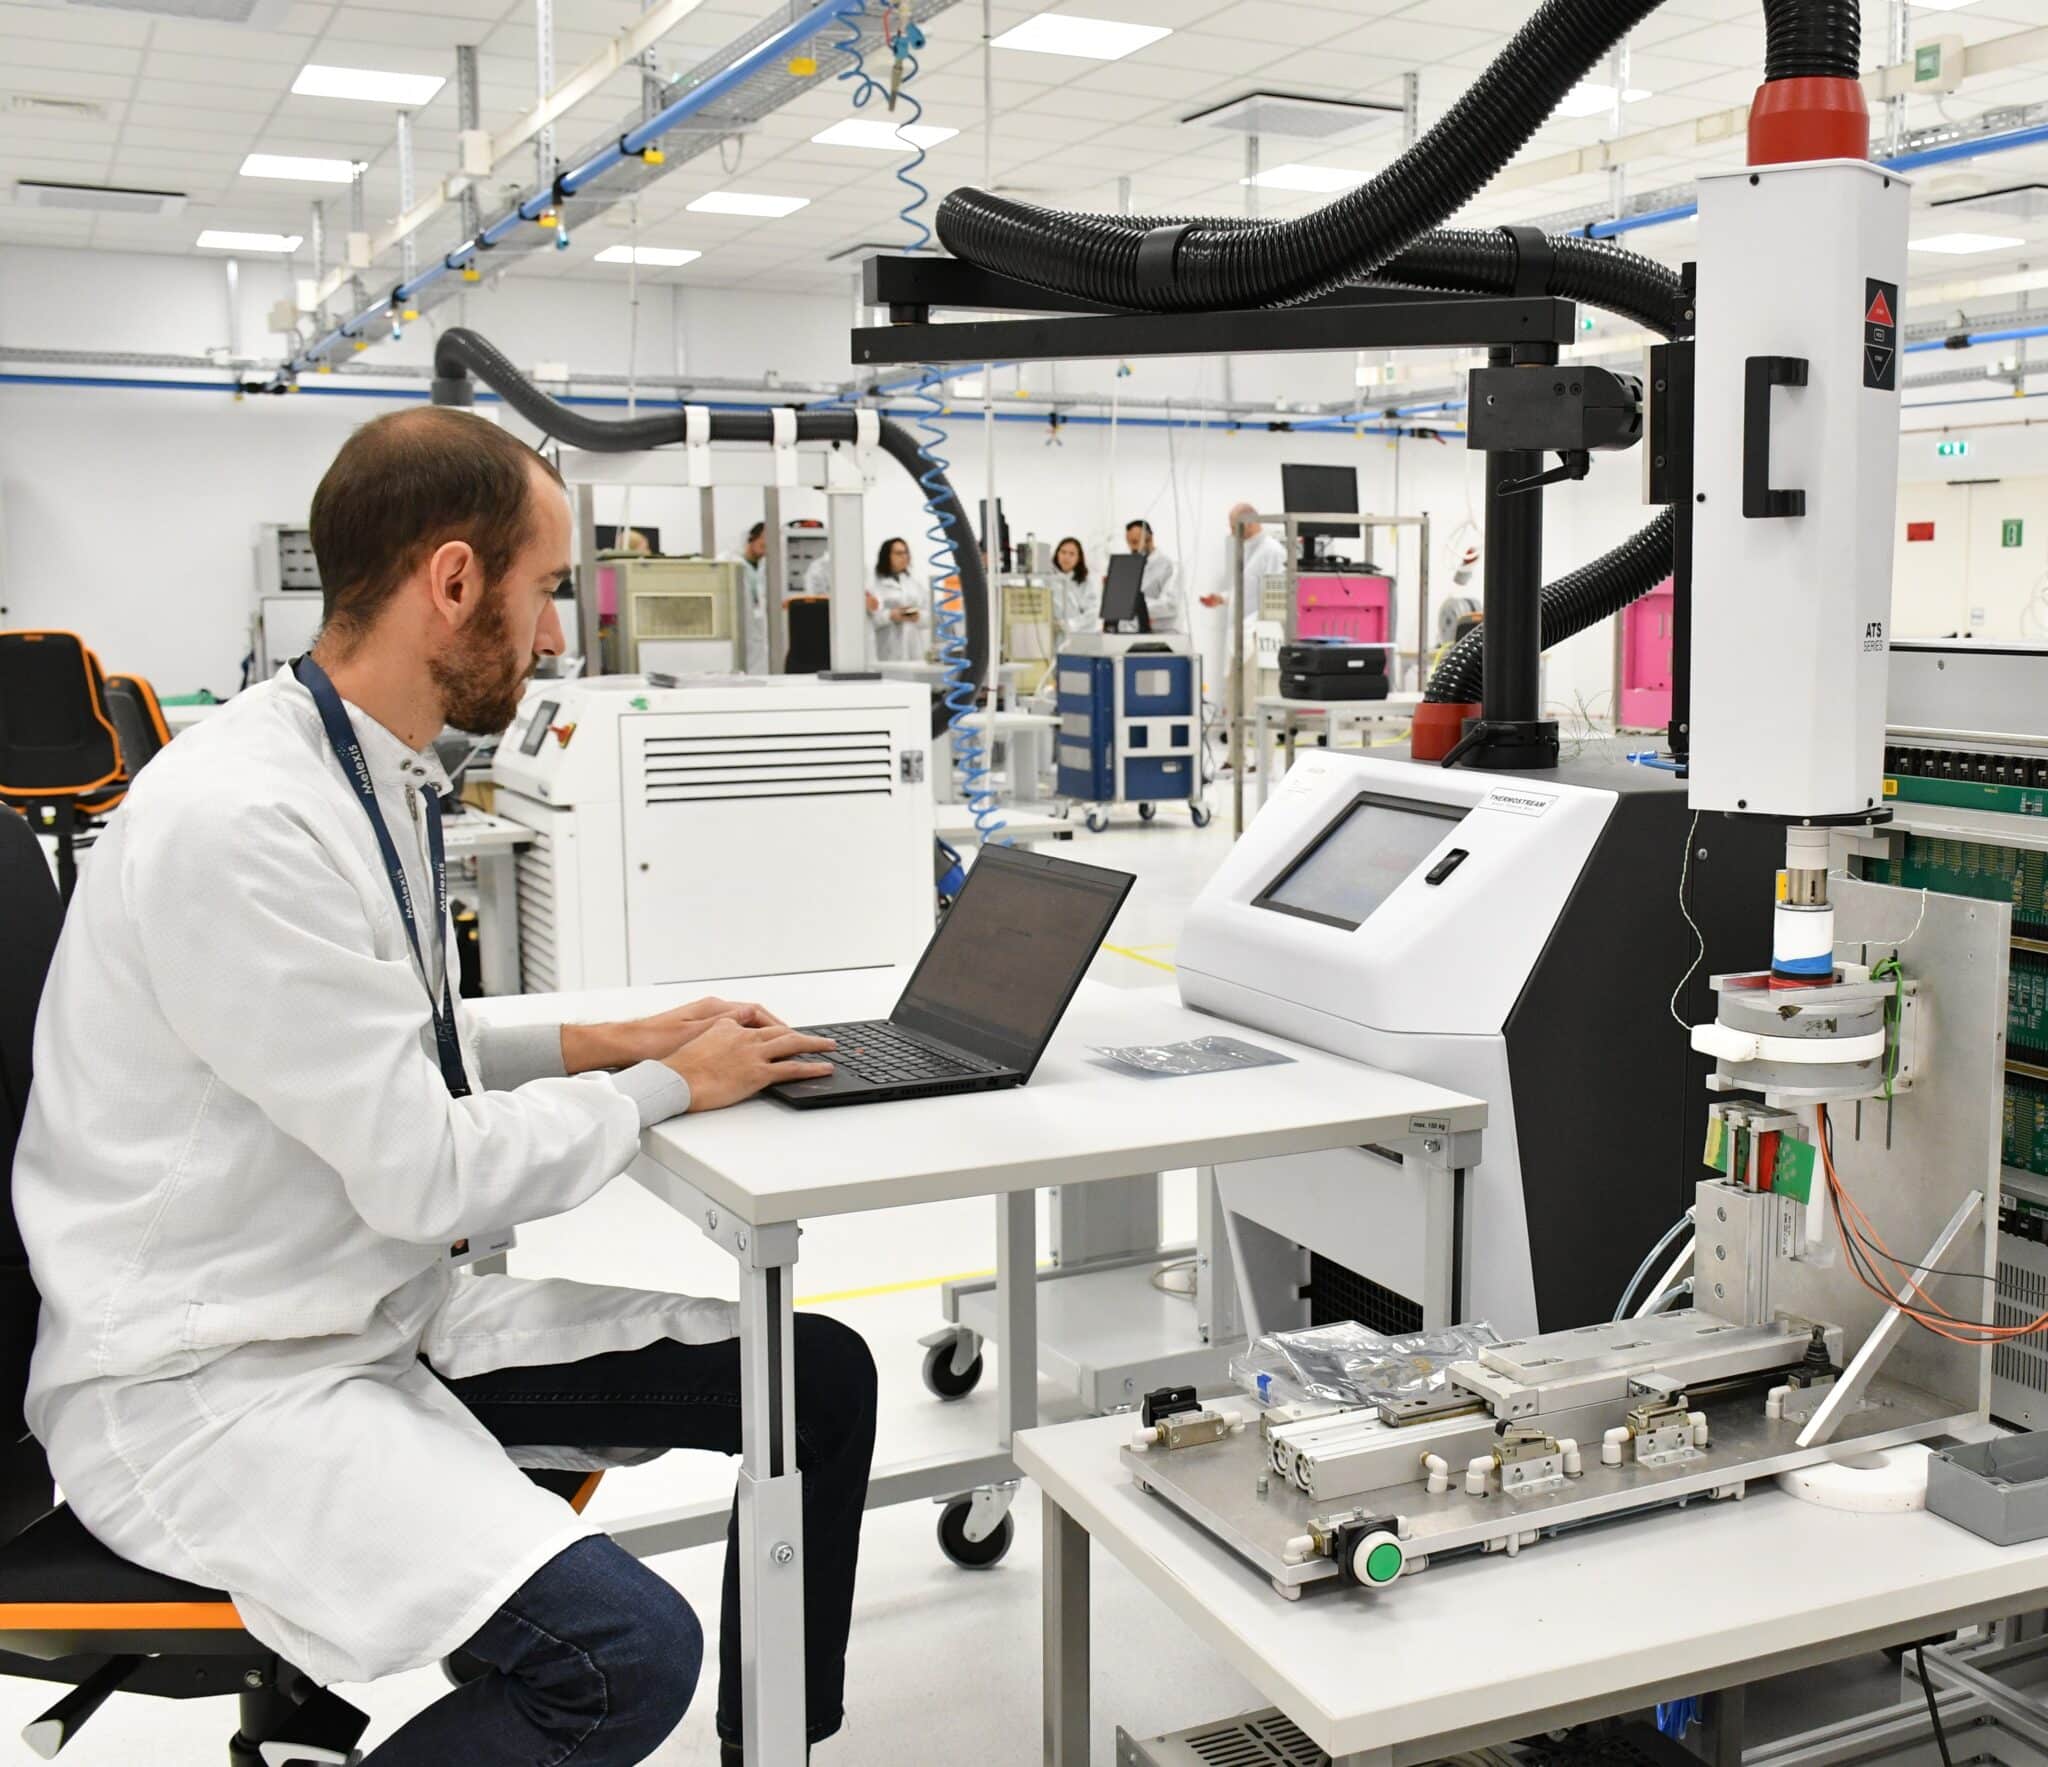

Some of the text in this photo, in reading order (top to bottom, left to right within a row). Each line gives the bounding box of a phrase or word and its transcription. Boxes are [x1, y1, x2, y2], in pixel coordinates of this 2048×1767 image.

[1865, 622, 1882, 638] ATS
[1863, 640, 1884, 652] SERIES
[348, 744, 374, 795] Melexis
[1490, 794, 1547, 808] THERMOSTREAM
[396, 868, 413, 919] Melexis
